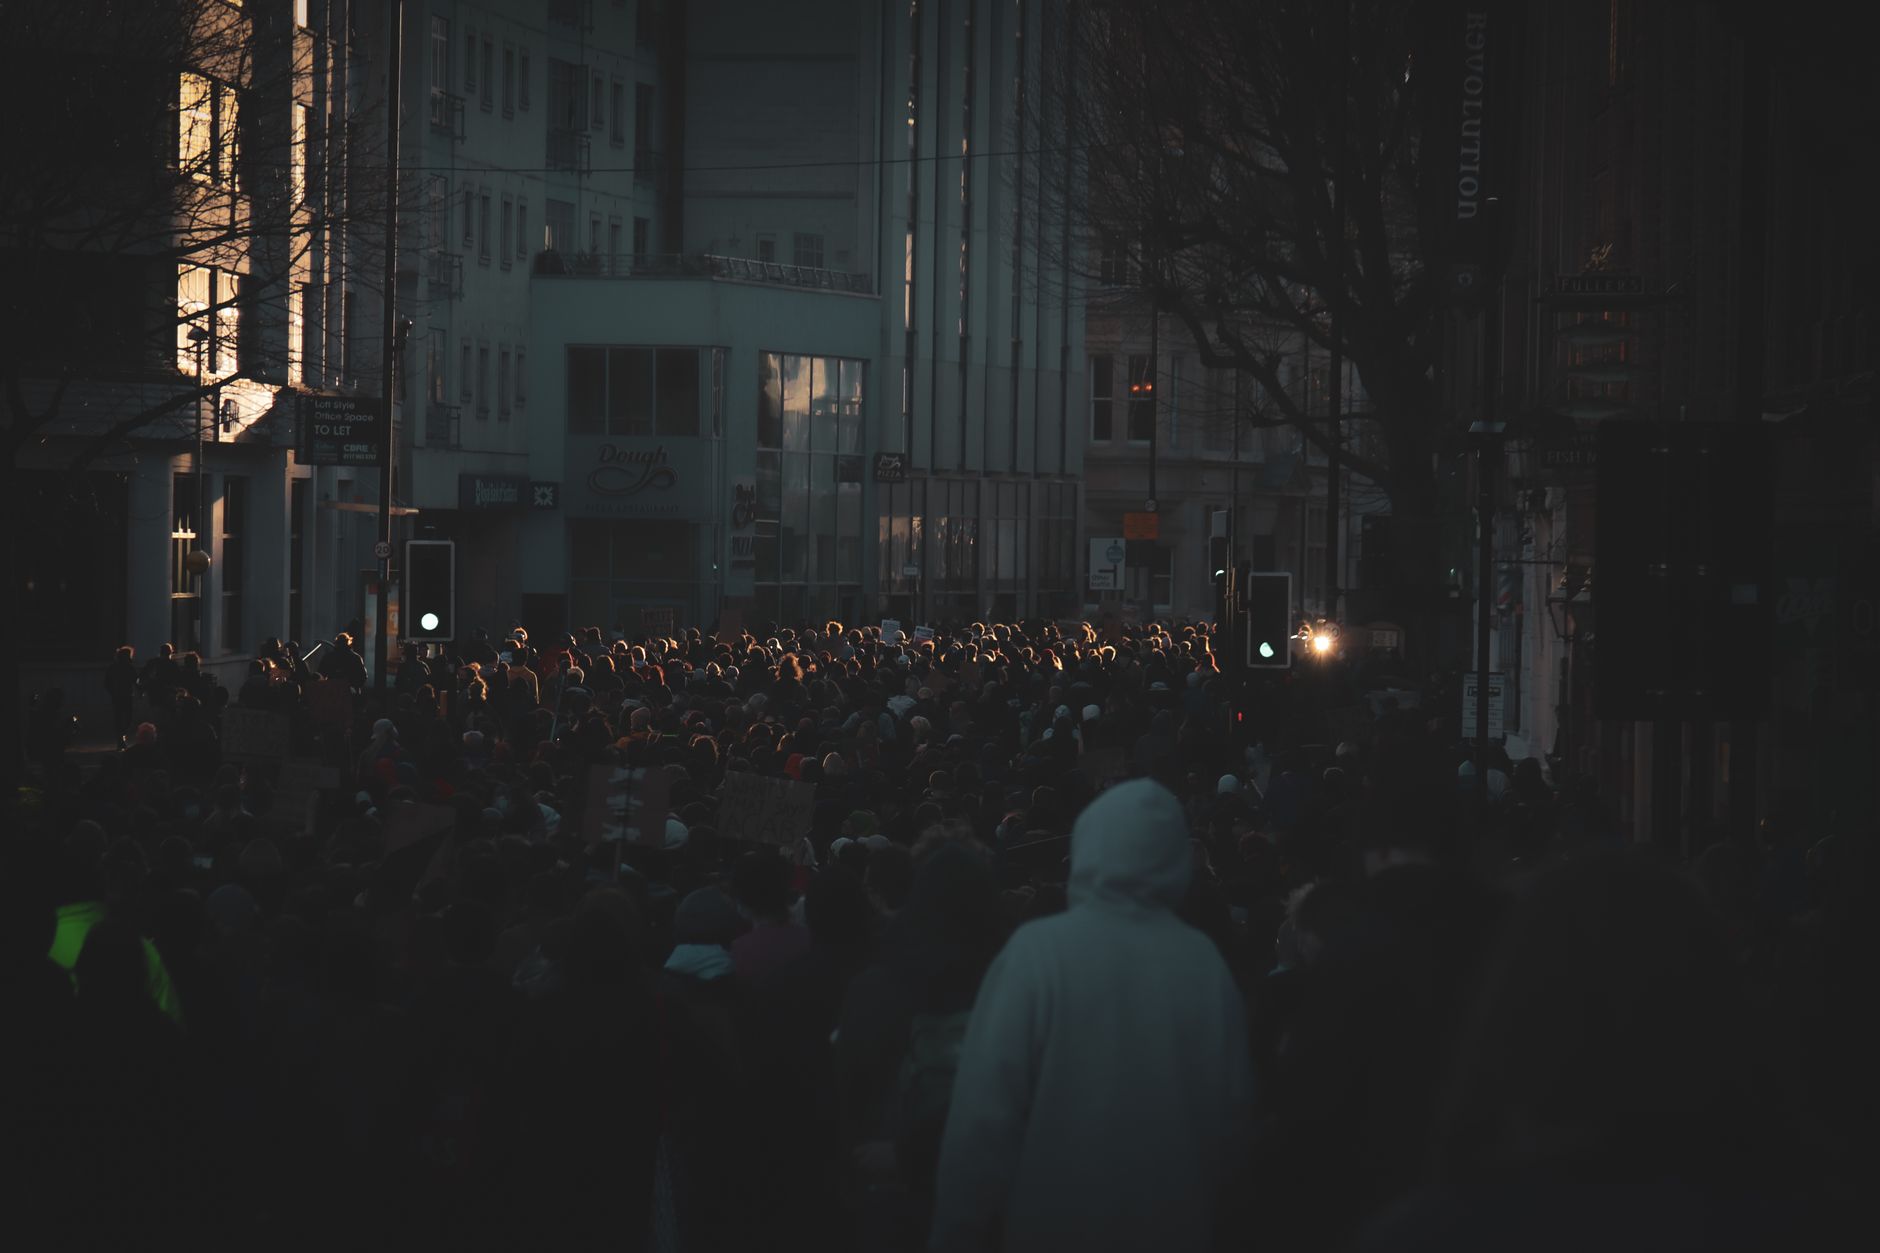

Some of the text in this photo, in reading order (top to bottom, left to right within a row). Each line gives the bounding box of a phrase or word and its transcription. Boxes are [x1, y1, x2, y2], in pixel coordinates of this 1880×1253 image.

[314, 400, 355, 411] Loft Style
[314, 411, 374, 423] Office Space
[314, 425, 352, 436] TO LET
[343, 443, 369, 453] CBRE
[876, 469, 902, 479] PIZZA
[376, 545, 389, 554] 20
